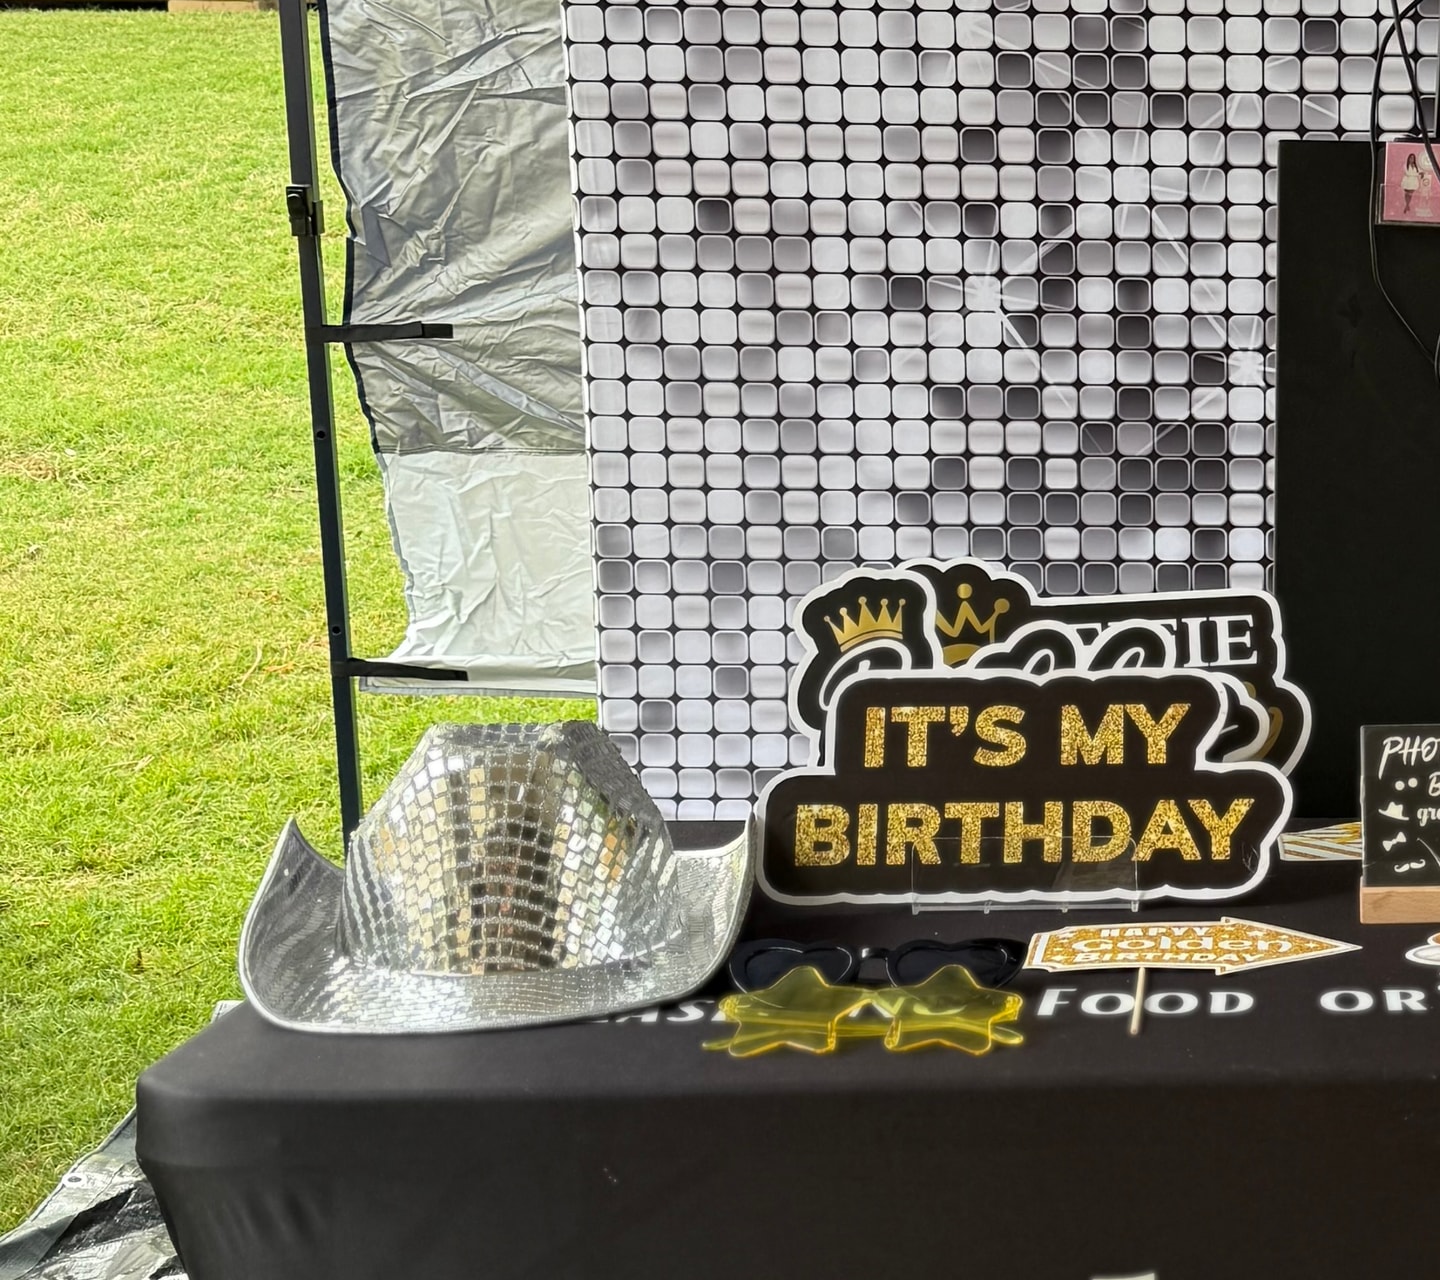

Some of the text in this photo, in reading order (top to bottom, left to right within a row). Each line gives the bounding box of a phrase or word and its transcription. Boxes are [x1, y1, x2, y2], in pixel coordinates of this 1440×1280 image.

[1060, 704, 1192, 765] MY
[794, 798, 1255, 867] BIRTHDAY
[1071, 936, 1293, 952] Golden
[1073, 952, 1265, 962] BIRTHDAY
[1036, 988, 1254, 1016] FOOD
[1320, 988, 1429, 1012] OR
